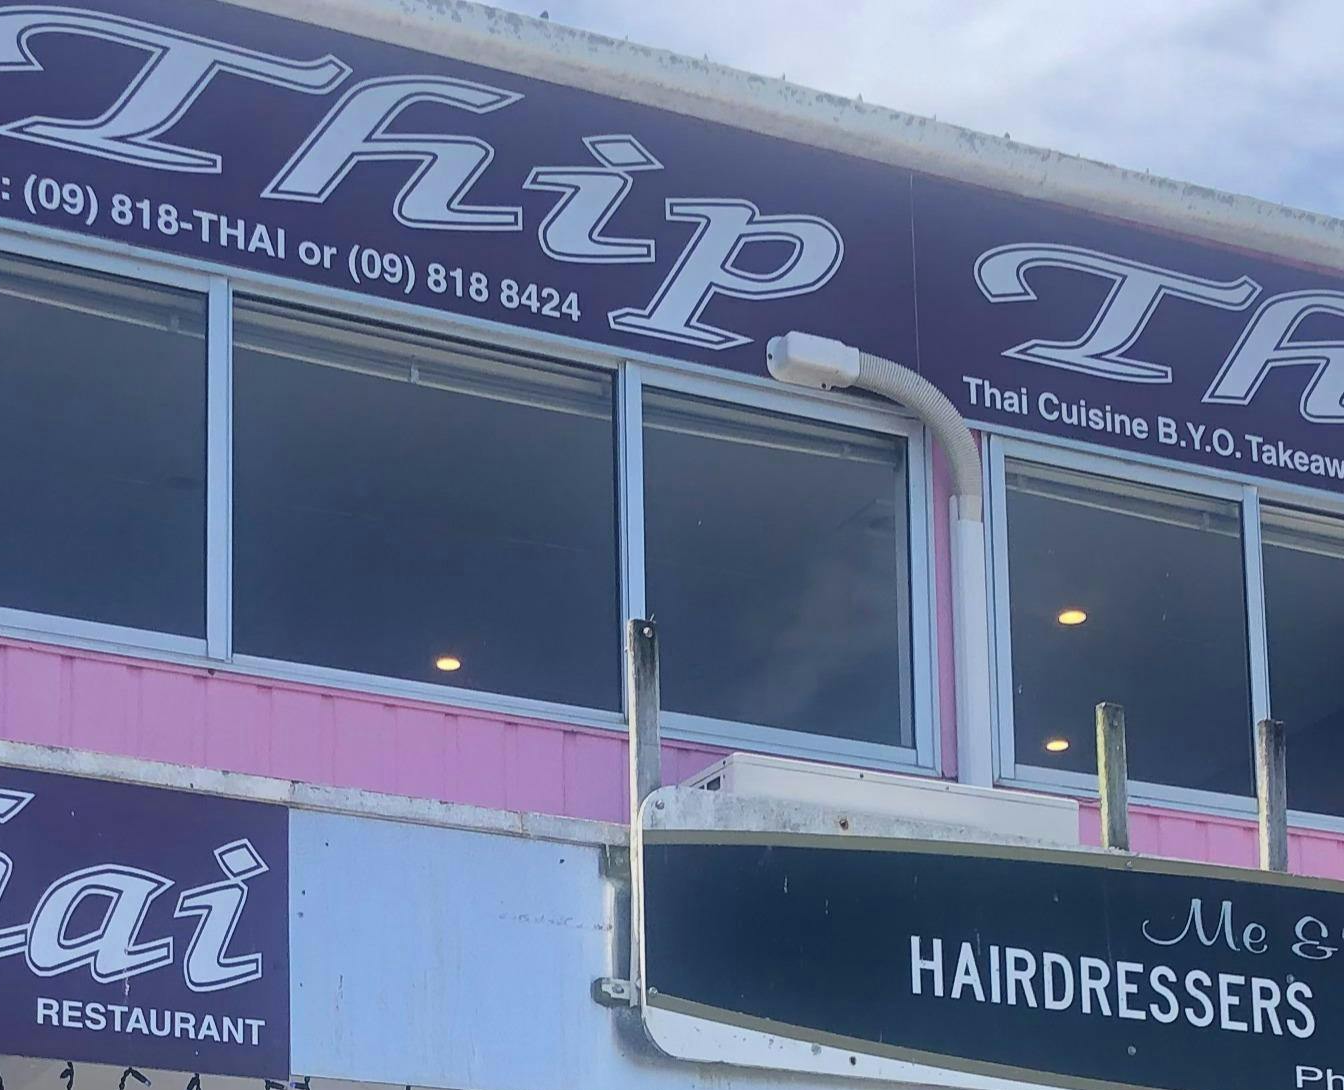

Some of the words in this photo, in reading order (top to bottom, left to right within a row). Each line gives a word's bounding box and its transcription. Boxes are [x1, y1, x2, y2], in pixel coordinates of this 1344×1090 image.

[24, 175, 98, 225] (09)
[111, 197, 284, 260] 818-THAI
[299, 242, 336, 268] or
[349, 245, 415, 293] (09)
[428, 263, 488, 301] 818
[501, 279, 580, 321] 8424
[961, 375, 1028, 417] Thai
[1039, 393, 1148, 438] Cuisine
[1158, 416, 1241, 458] B.Y.O.
[1143, 899, 1267, 953] Me
[37, 998, 265, 1045] RESTAURANT
[910, 935, 1317, 1040] HAIRDRESSERS
